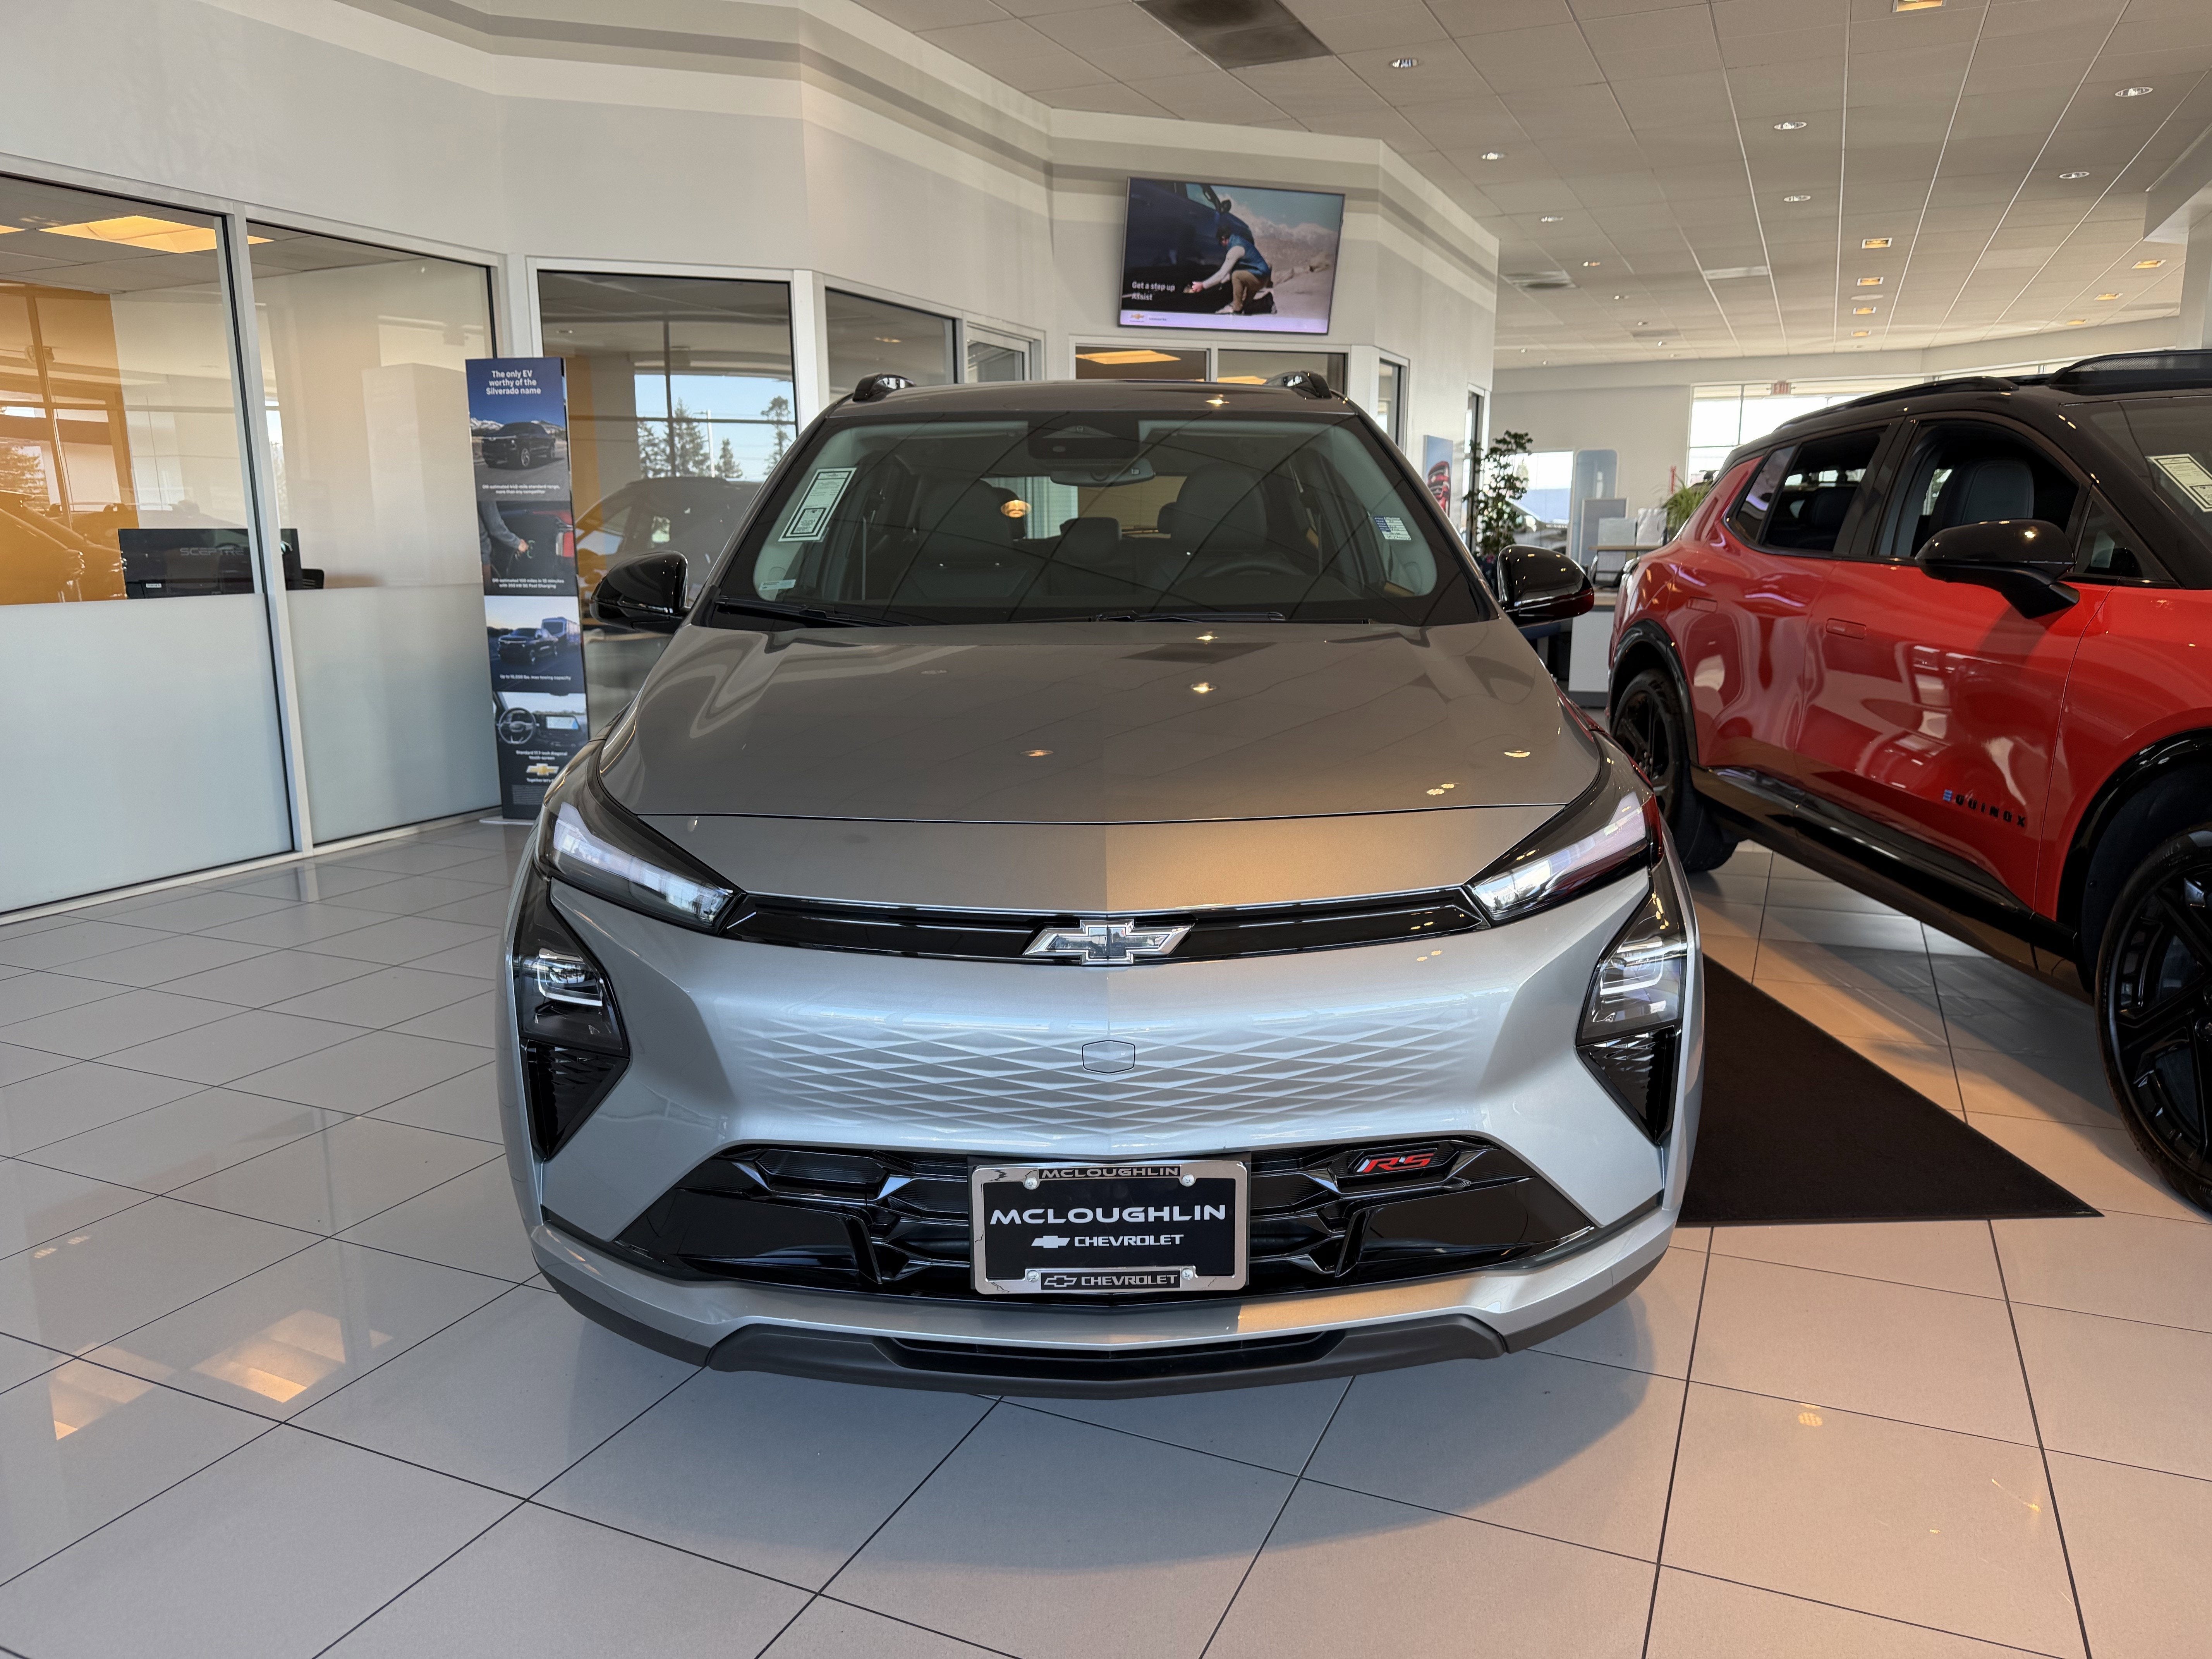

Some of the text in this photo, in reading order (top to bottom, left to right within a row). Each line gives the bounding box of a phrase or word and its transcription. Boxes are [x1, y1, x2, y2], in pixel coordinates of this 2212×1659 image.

[1132, 281, 1144, 289] Get
[1150, 282, 1166, 292] step
[1166, 284, 1175, 292] up
[491, 370, 505, 378] The
[506, 370, 521, 379] only
[489, 379, 514, 387] worthy
[180, 547, 244, 555] SCEPTRE
[1942, 789, 2026, 828] EQUINOX
[1357, 1152, 1435, 1173] RS
[1041, 1167, 1179, 1178] MCLOUGHLIN
[990, 1204, 1225, 1225] MCLOUGHLIN
[1074, 1234, 1184, 1247] CHEVROLET
[1081, 1274, 1178, 1286] CHEVROLET
